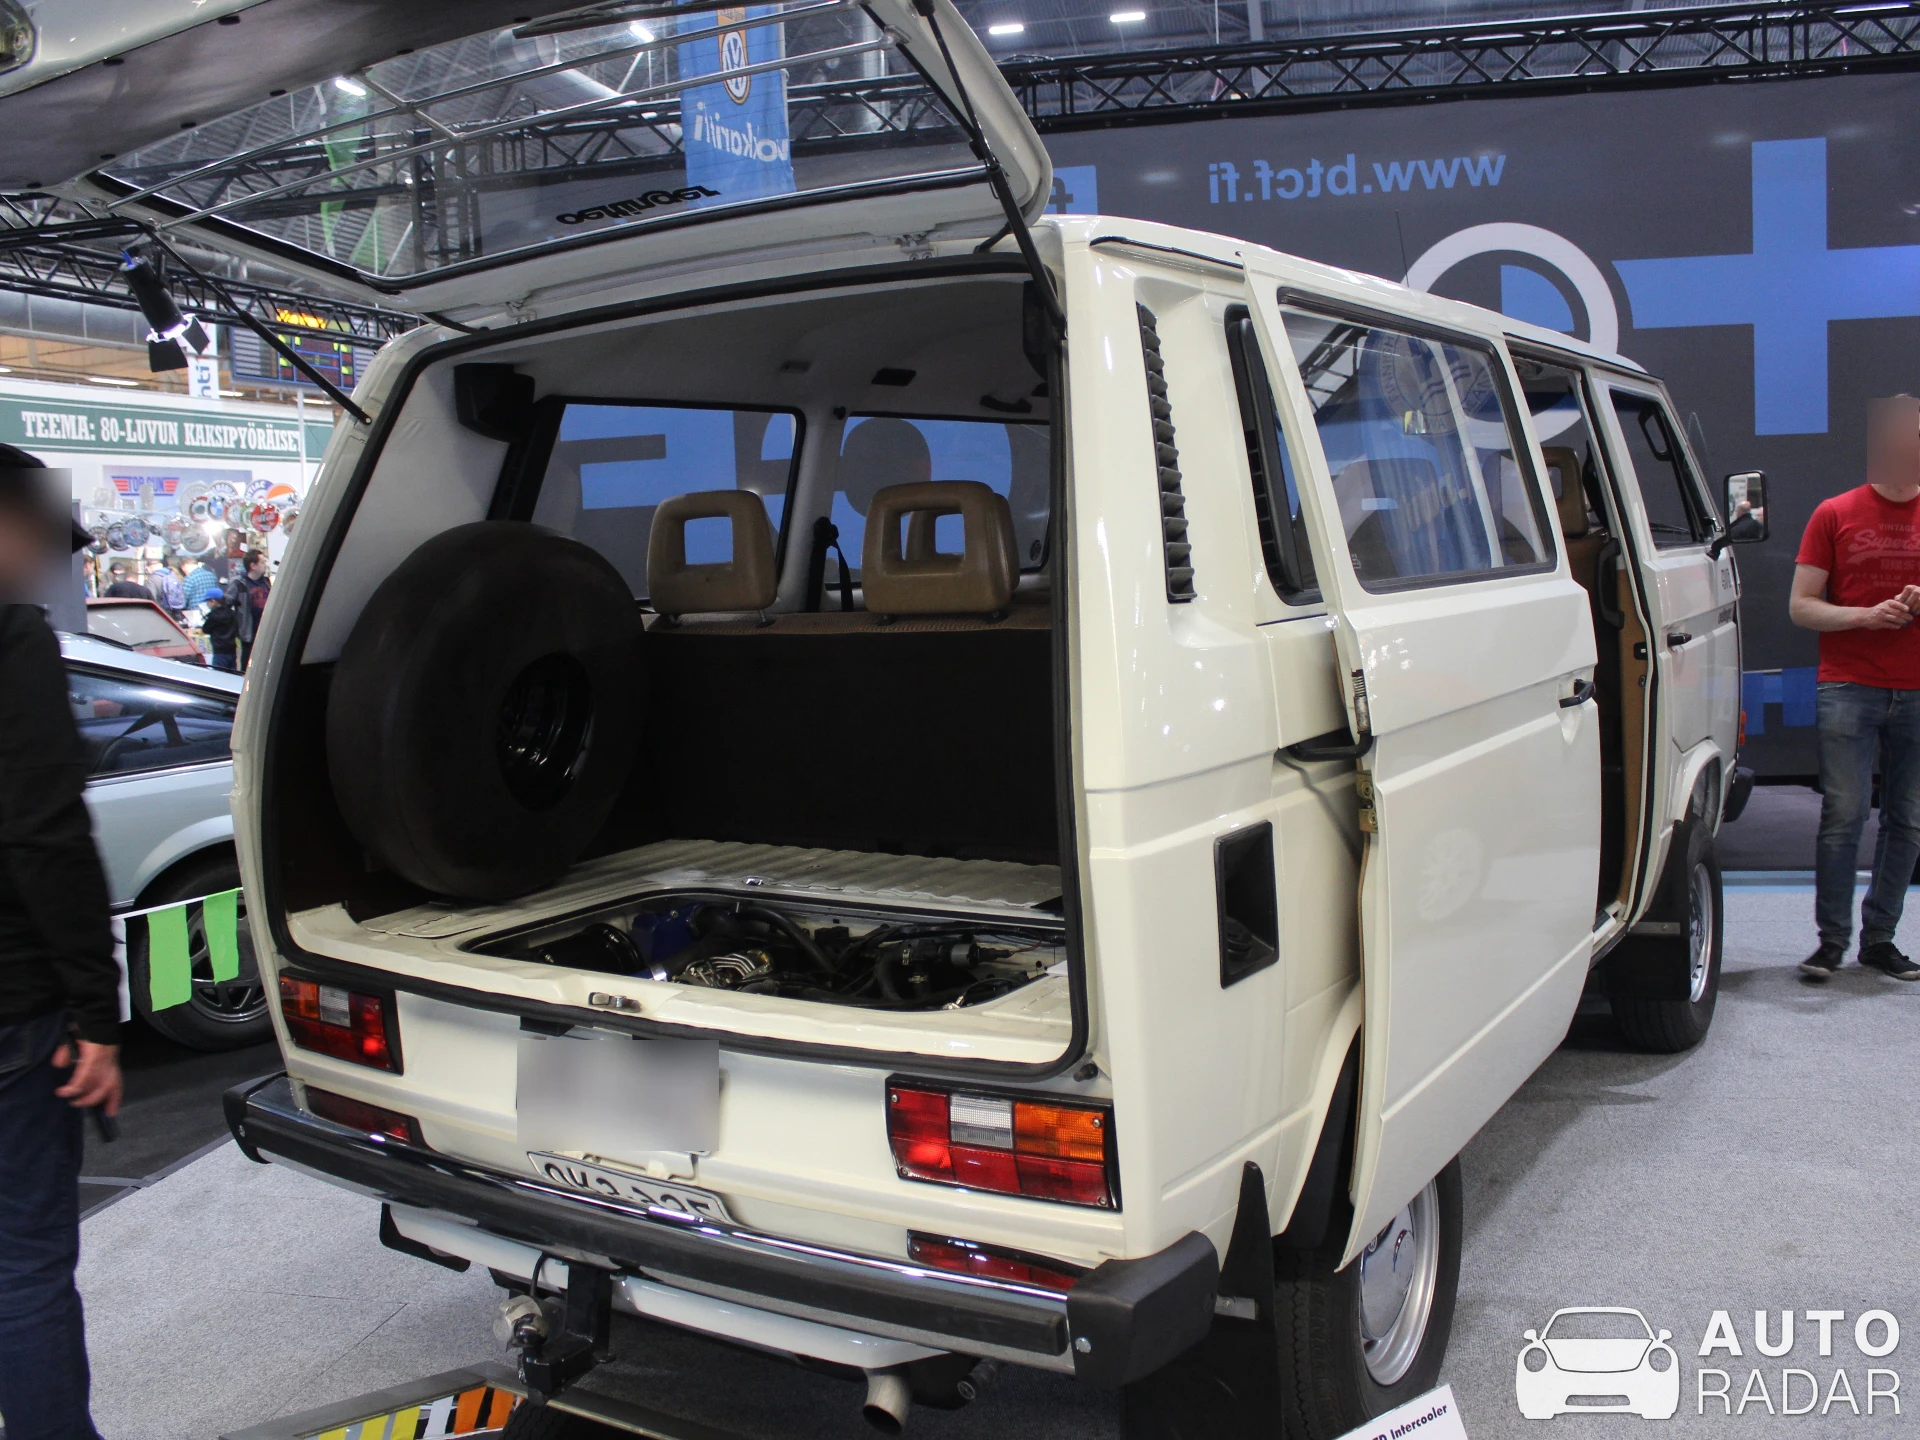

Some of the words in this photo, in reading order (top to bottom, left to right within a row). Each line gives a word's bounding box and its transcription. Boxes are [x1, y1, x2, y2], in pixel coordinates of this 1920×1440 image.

[21, 410, 96, 441] TEEMA:
[100, 416, 179, 446] 80-LUVUN
[1390, 1404, 1448, 1440] Intercooler
